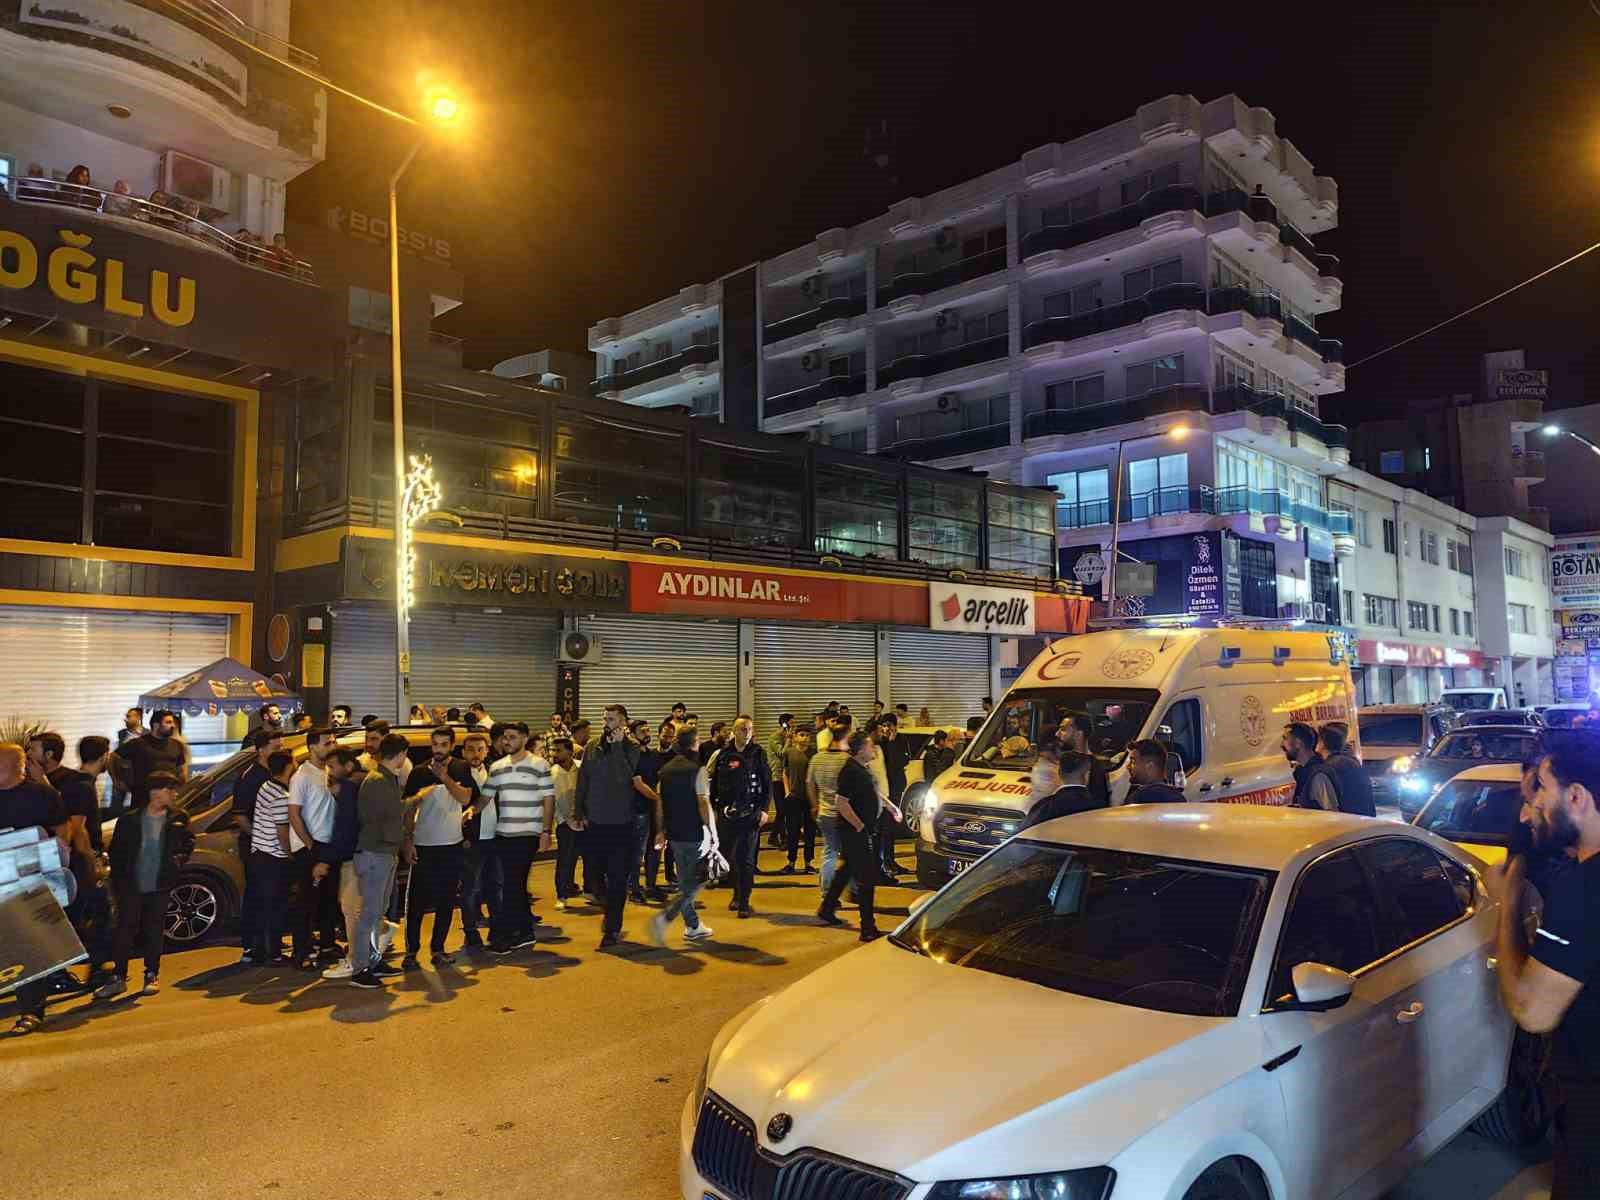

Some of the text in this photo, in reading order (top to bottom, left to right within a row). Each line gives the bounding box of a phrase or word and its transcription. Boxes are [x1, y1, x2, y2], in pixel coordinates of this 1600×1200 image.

[0, 229, 196, 327] OĞLU
[1191, 565, 1215, 574] Dilek
[657, 572, 781, 601] AYDINLAR
[963, 597, 1029, 630] arçelik
